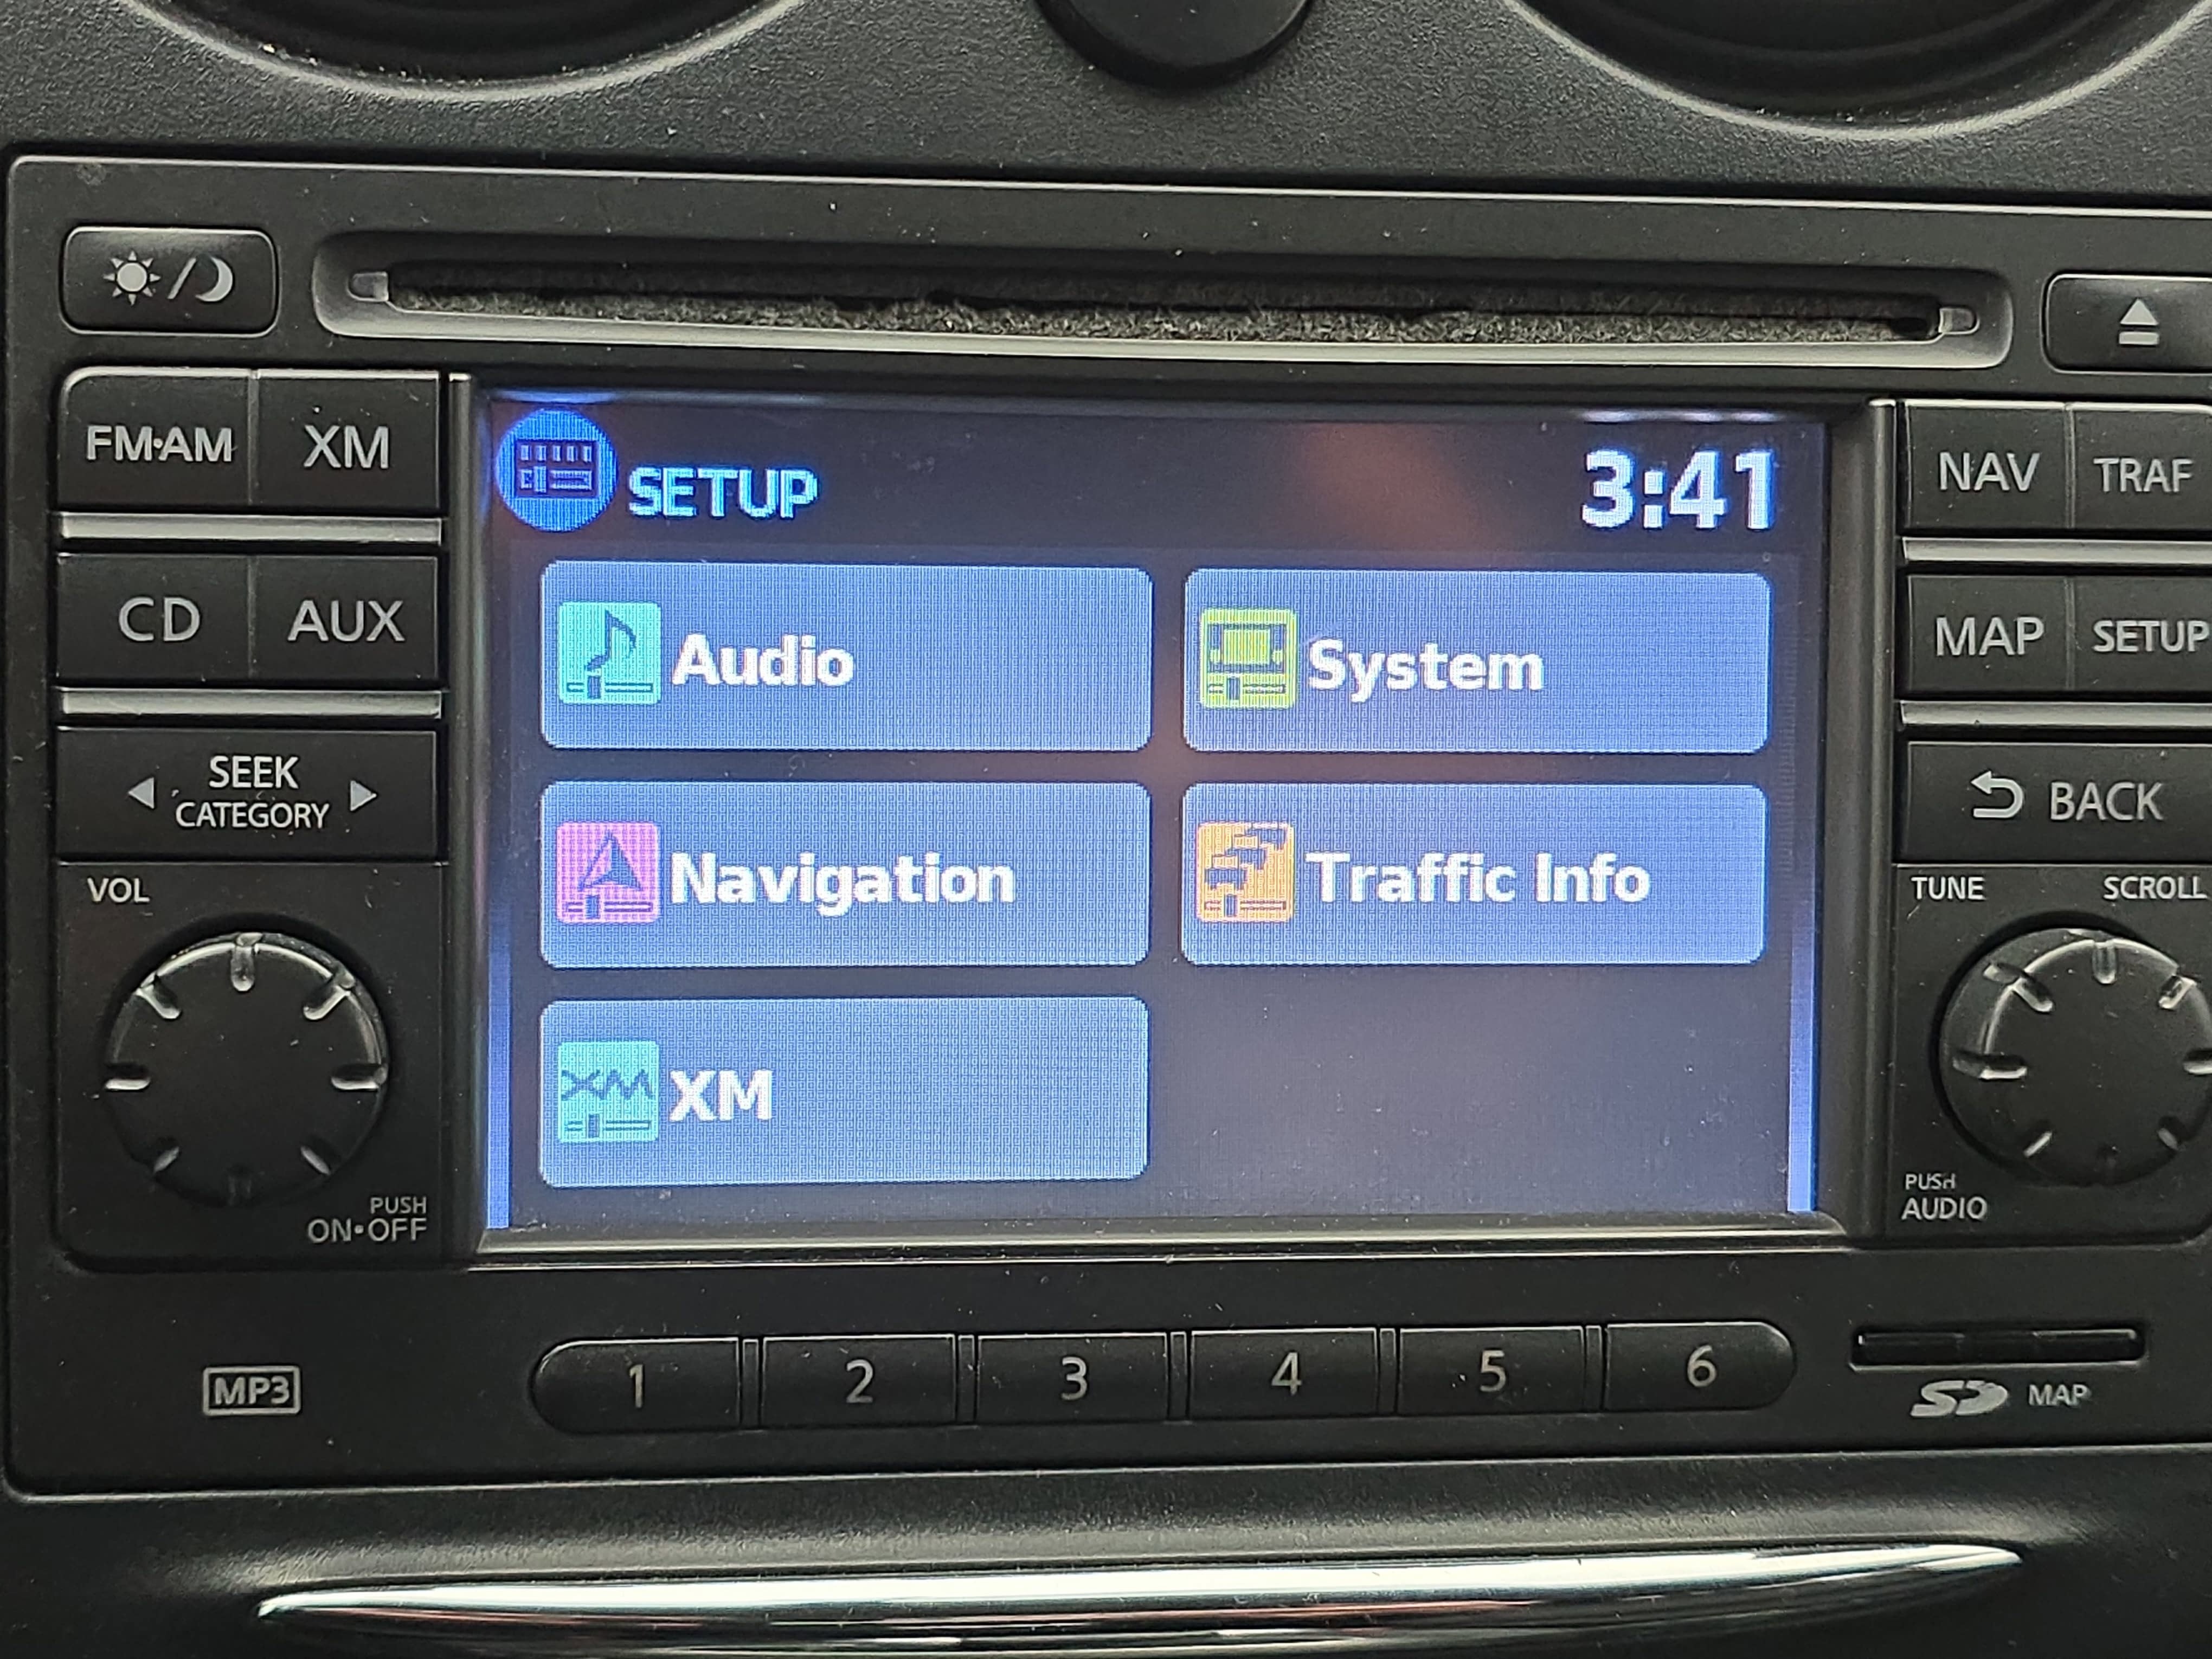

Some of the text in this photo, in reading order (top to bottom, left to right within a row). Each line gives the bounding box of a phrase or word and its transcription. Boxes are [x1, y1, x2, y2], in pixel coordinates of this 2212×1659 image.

[304, 425, 389, 469] XM
[628, 466, 820, 519] SETUP
[1581, 448, 1776, 531] 3:41
[1939, 452, 2040, 491] NAV
[2093, 458, 2194, 493] TRAF
[118, 596, 201, 642] CD
[288, 600, 405, 642] AUX
[1935, 616, 2044, 657] MAP
[2093, 620, 2210, 653] SETUP
[672, 633, 855, 687] Audio
[1308, 638, 1545, 704] System
[209, 755, 299, 789] SEEK
[175, 802, 330, 829] CATEGORY
[2050, 782, 2164, 821] BACK
[87, 877, 150, 903] VOL
[670, 851, 1015, 918] Navigation
[1304, 850, 1650, 905] Traffic Info
[1911, 876, 1986, 901] TUNE
[2104, 876, 2208, 900] SCROLL
[670, 1069, 774, 1123] XM
[1905, 1173, 1956, 1191] PUSH
[370, 1196, 427, 1215] PUSH
[1901, 1197, 1988, 1221] AUDIO
[627, 1364, 646, 1409] 1
[845, 1359, 874, 1404] 2
[1060, 1356, 1089, 1401] 3
[1271, 1351, 1302, 1396] 4
[1480, 1349, 1508, 1393] 5
[1686, 1345, 1718, 1388] 6
[215, 1375, 290, 1406] MP3
[1910, 1380, 2092, 1417] SD MAP
